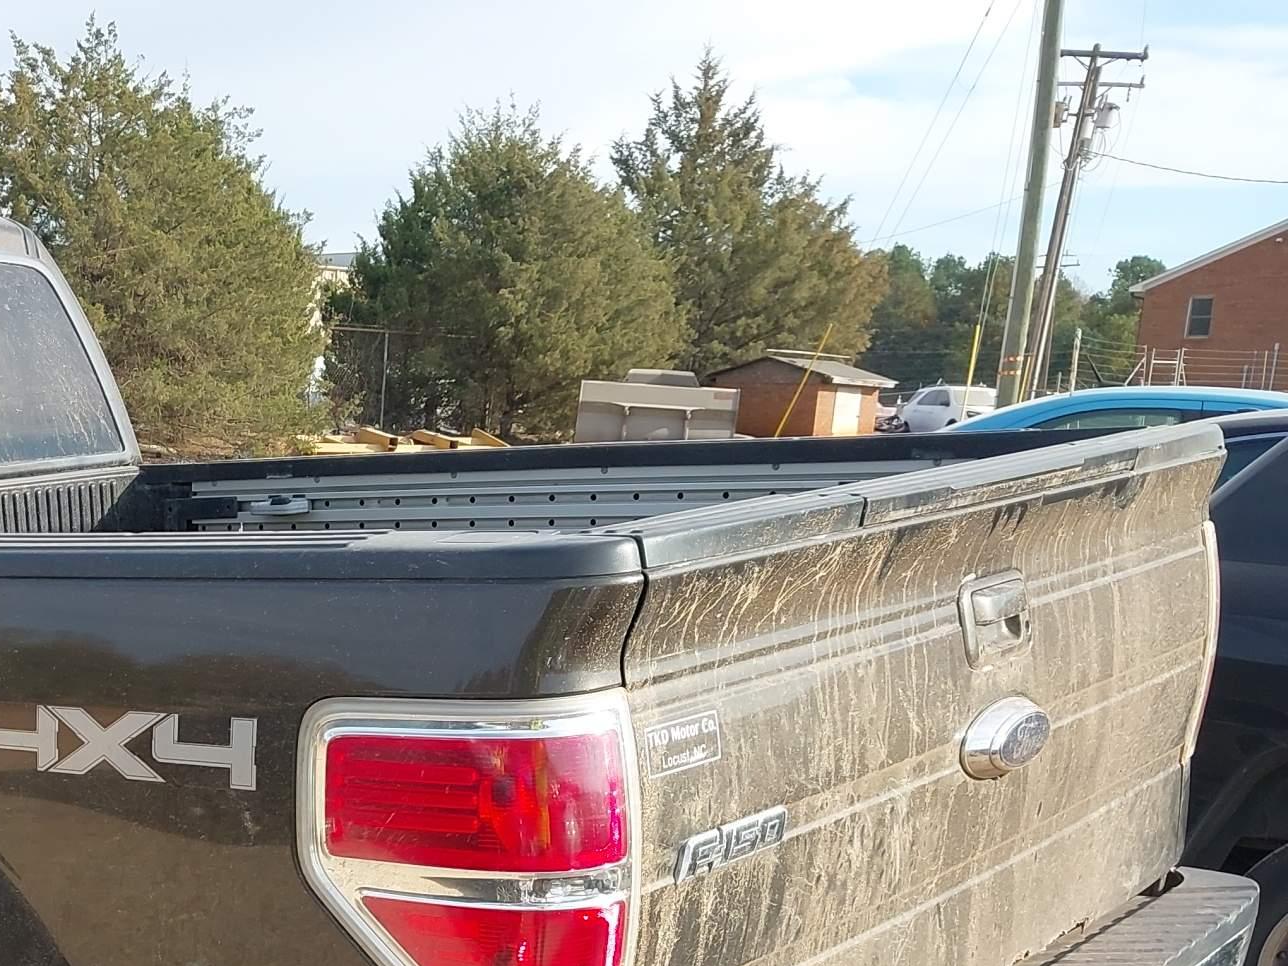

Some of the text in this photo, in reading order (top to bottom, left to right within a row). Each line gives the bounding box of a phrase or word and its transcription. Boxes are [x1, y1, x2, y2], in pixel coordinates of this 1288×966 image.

[671, 723, 700, 741] Motor
[701, 717, 717, 733] Co.
[673, 805, 787, 885] F-150
